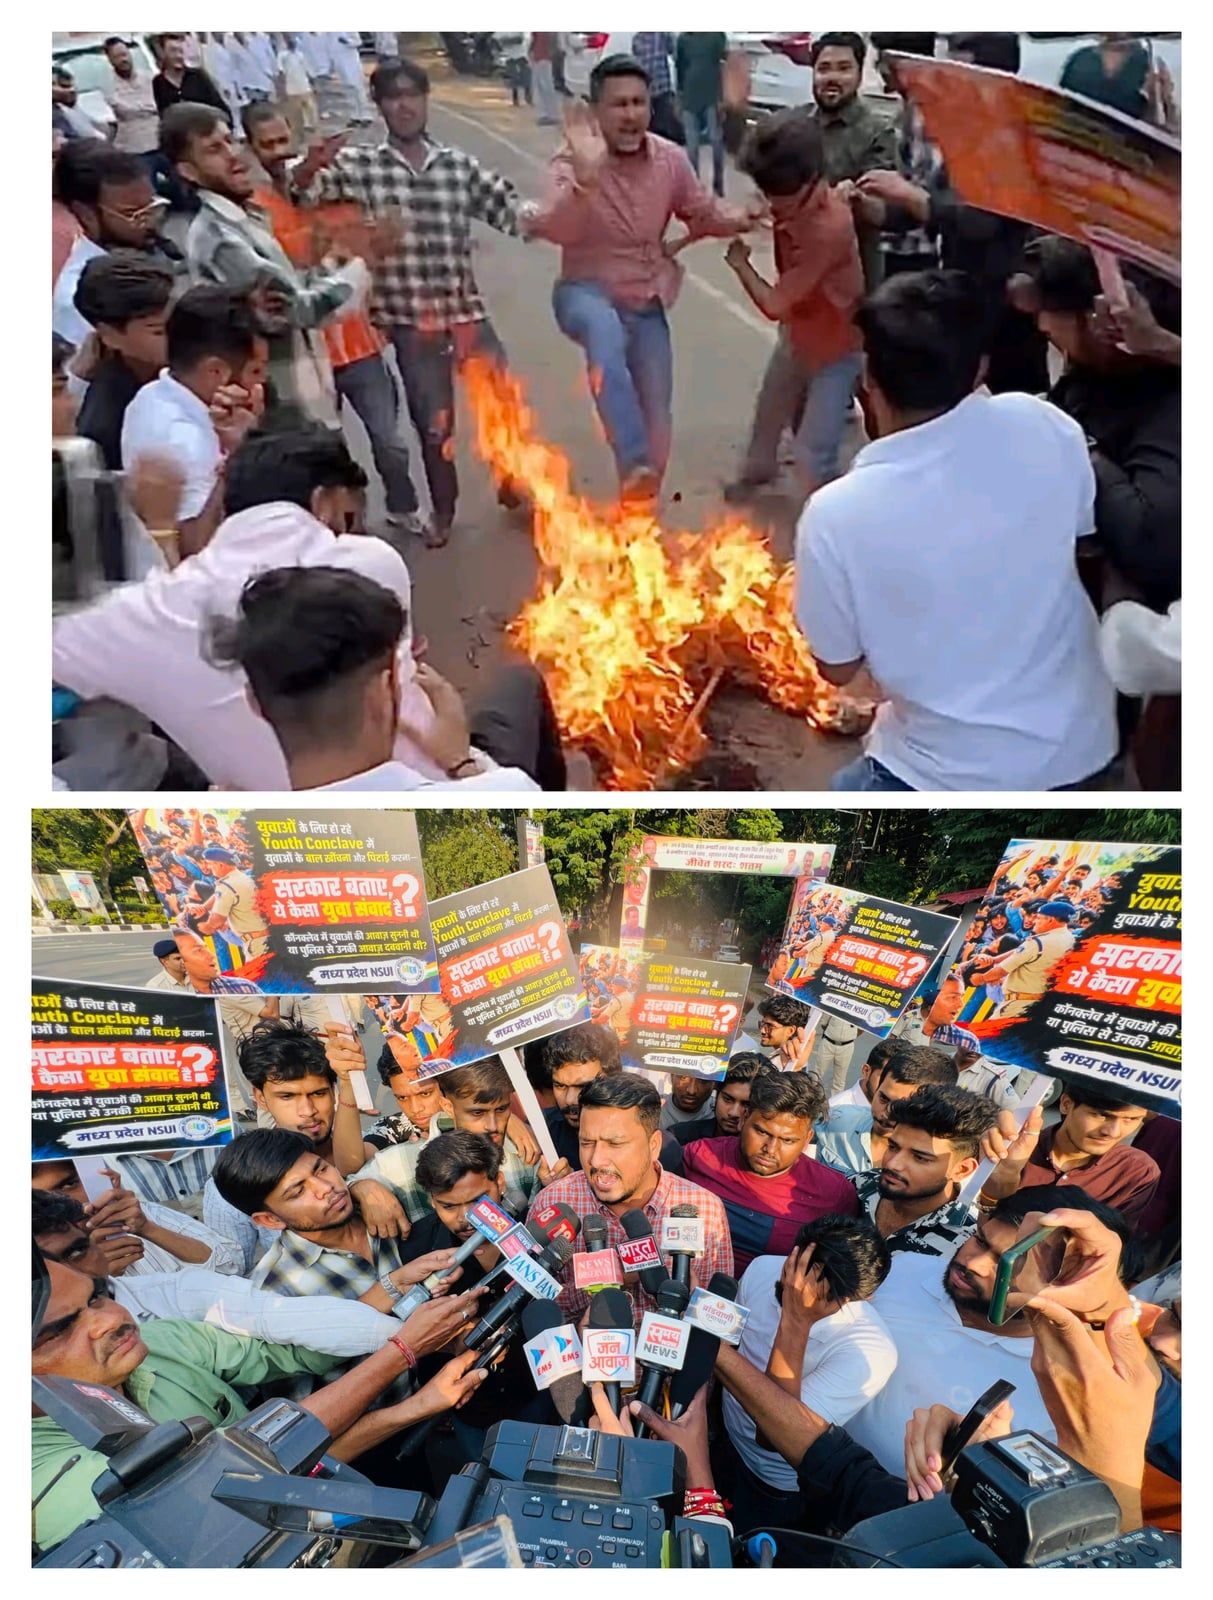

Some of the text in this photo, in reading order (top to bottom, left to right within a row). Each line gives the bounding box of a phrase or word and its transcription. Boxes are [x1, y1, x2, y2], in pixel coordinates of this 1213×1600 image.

[256, 818, 352, 836] युवाओं के लिए हो रहे
[261, 837, 375, 849] Youth Conclave में
[265, 851, 389, 866] युवाओं के बाल और पिटाई
[272, 877, 341, 898] सरकार
[344, 877, 393, 899] बताए,
[272, 901, 286, 918] ये
[288, 901, 320, 917] कैसा
[320, 901, 352, 922] युवा
[354, 899, 392, 917] संवाद
[431, 911, 459, 934] युवाओं
[433, 907, 511, 944] Youth Conclave
[855, 916, 875, 928] Youth
[876, 922, 910, 936] Conclave
[1113, 912, 1177, 929] युवाओं के
[284, 931, 319, 942] कॉनक्लेव
[321, 931, 329, 941] में
[330, 931, 353, 944] युवाओं
[355, 930, 364, 941] की
[411, 929, 420, 939] थी
[288, 943, 357, 957] या पुलिस से उनकी
[447, 946, 500, 981] सरकार
[500, 933, 540, 958] बताए,
[840, 940, 879, 958] सरकार
[320, 967, 394, 979] मध्य प्रदेश NSUI
[451, 952, 543, 998] ये कैसा युवा संवाद
[1067, 966, 1089, 988] ये
[1088, 968, 1139, 995] कैसा
[674, 977, 710, 988] Conclave
[64, 997, 136, 1013] के लिए हो रहे
[644, 999, 687, 1013] सरकार
[853, 1004, 868, 1015] NSUI
[72, 1012, 163, 1026] Conclave में
[494, 1009, 552, 1039] मध्य प्रदेश NSUI
[1054, 1003, 1178, 1037] कॉनक्लेव में युवाओं की
[55, 1023, 181, 1038] के बाल खींचना और पिटाई
[1046, 1017, 1061, 1028] या
[1060, 1020, 1097, 1036] पुलिस
[1098, 1028, 1113, 1040] से
[1111, 1031, 1150, 1048] उनकी
[32, 1047, 116, 1066] सरकार
[120, 1048, 182, 1067] बताए,
[682, 1058, 697, 1066] NSUI
[38, 1067, 83, 1084] कैसा
[86, 1068, 128, 1088] युवा
[131, 1065, 179, 1083] संवाद
[1061, 1051, 1181, 1091] मध्य प्रदेश NSUI
[82, 1096, 93, 1106] में
[95, 1094, 127, 1107] युवाओं
[129, 1094, 142, 1104] की
[175, 1094, 199, 1103] सुननी
[200, 1092, 211, 1100] थी
[32, 1112, 47, 1120] या
[50, 1110, 87, 1123] पुलिस
[90, 1108, 101, 1118] से
[103, 1106, 132, 1116] उनकी
[77, 1125, 177, 1142] मध्य प्रदेश NSUI
[516, 1231, 532, 1249] NEWS
[619, 1239, 652, 1259] भारत
[509, 1256, 541, 1283] IANS
[577, 1257, 611, 1270] NEWS
[597, 1342, 620, 1354] जन
[644, 1343, 678, 1359] NEWS
[562, 1352, 579, 1362] EMS
[537, 1361, 552, 1376] EMS
[985, 1484, 1003, 1501] LIGHT
